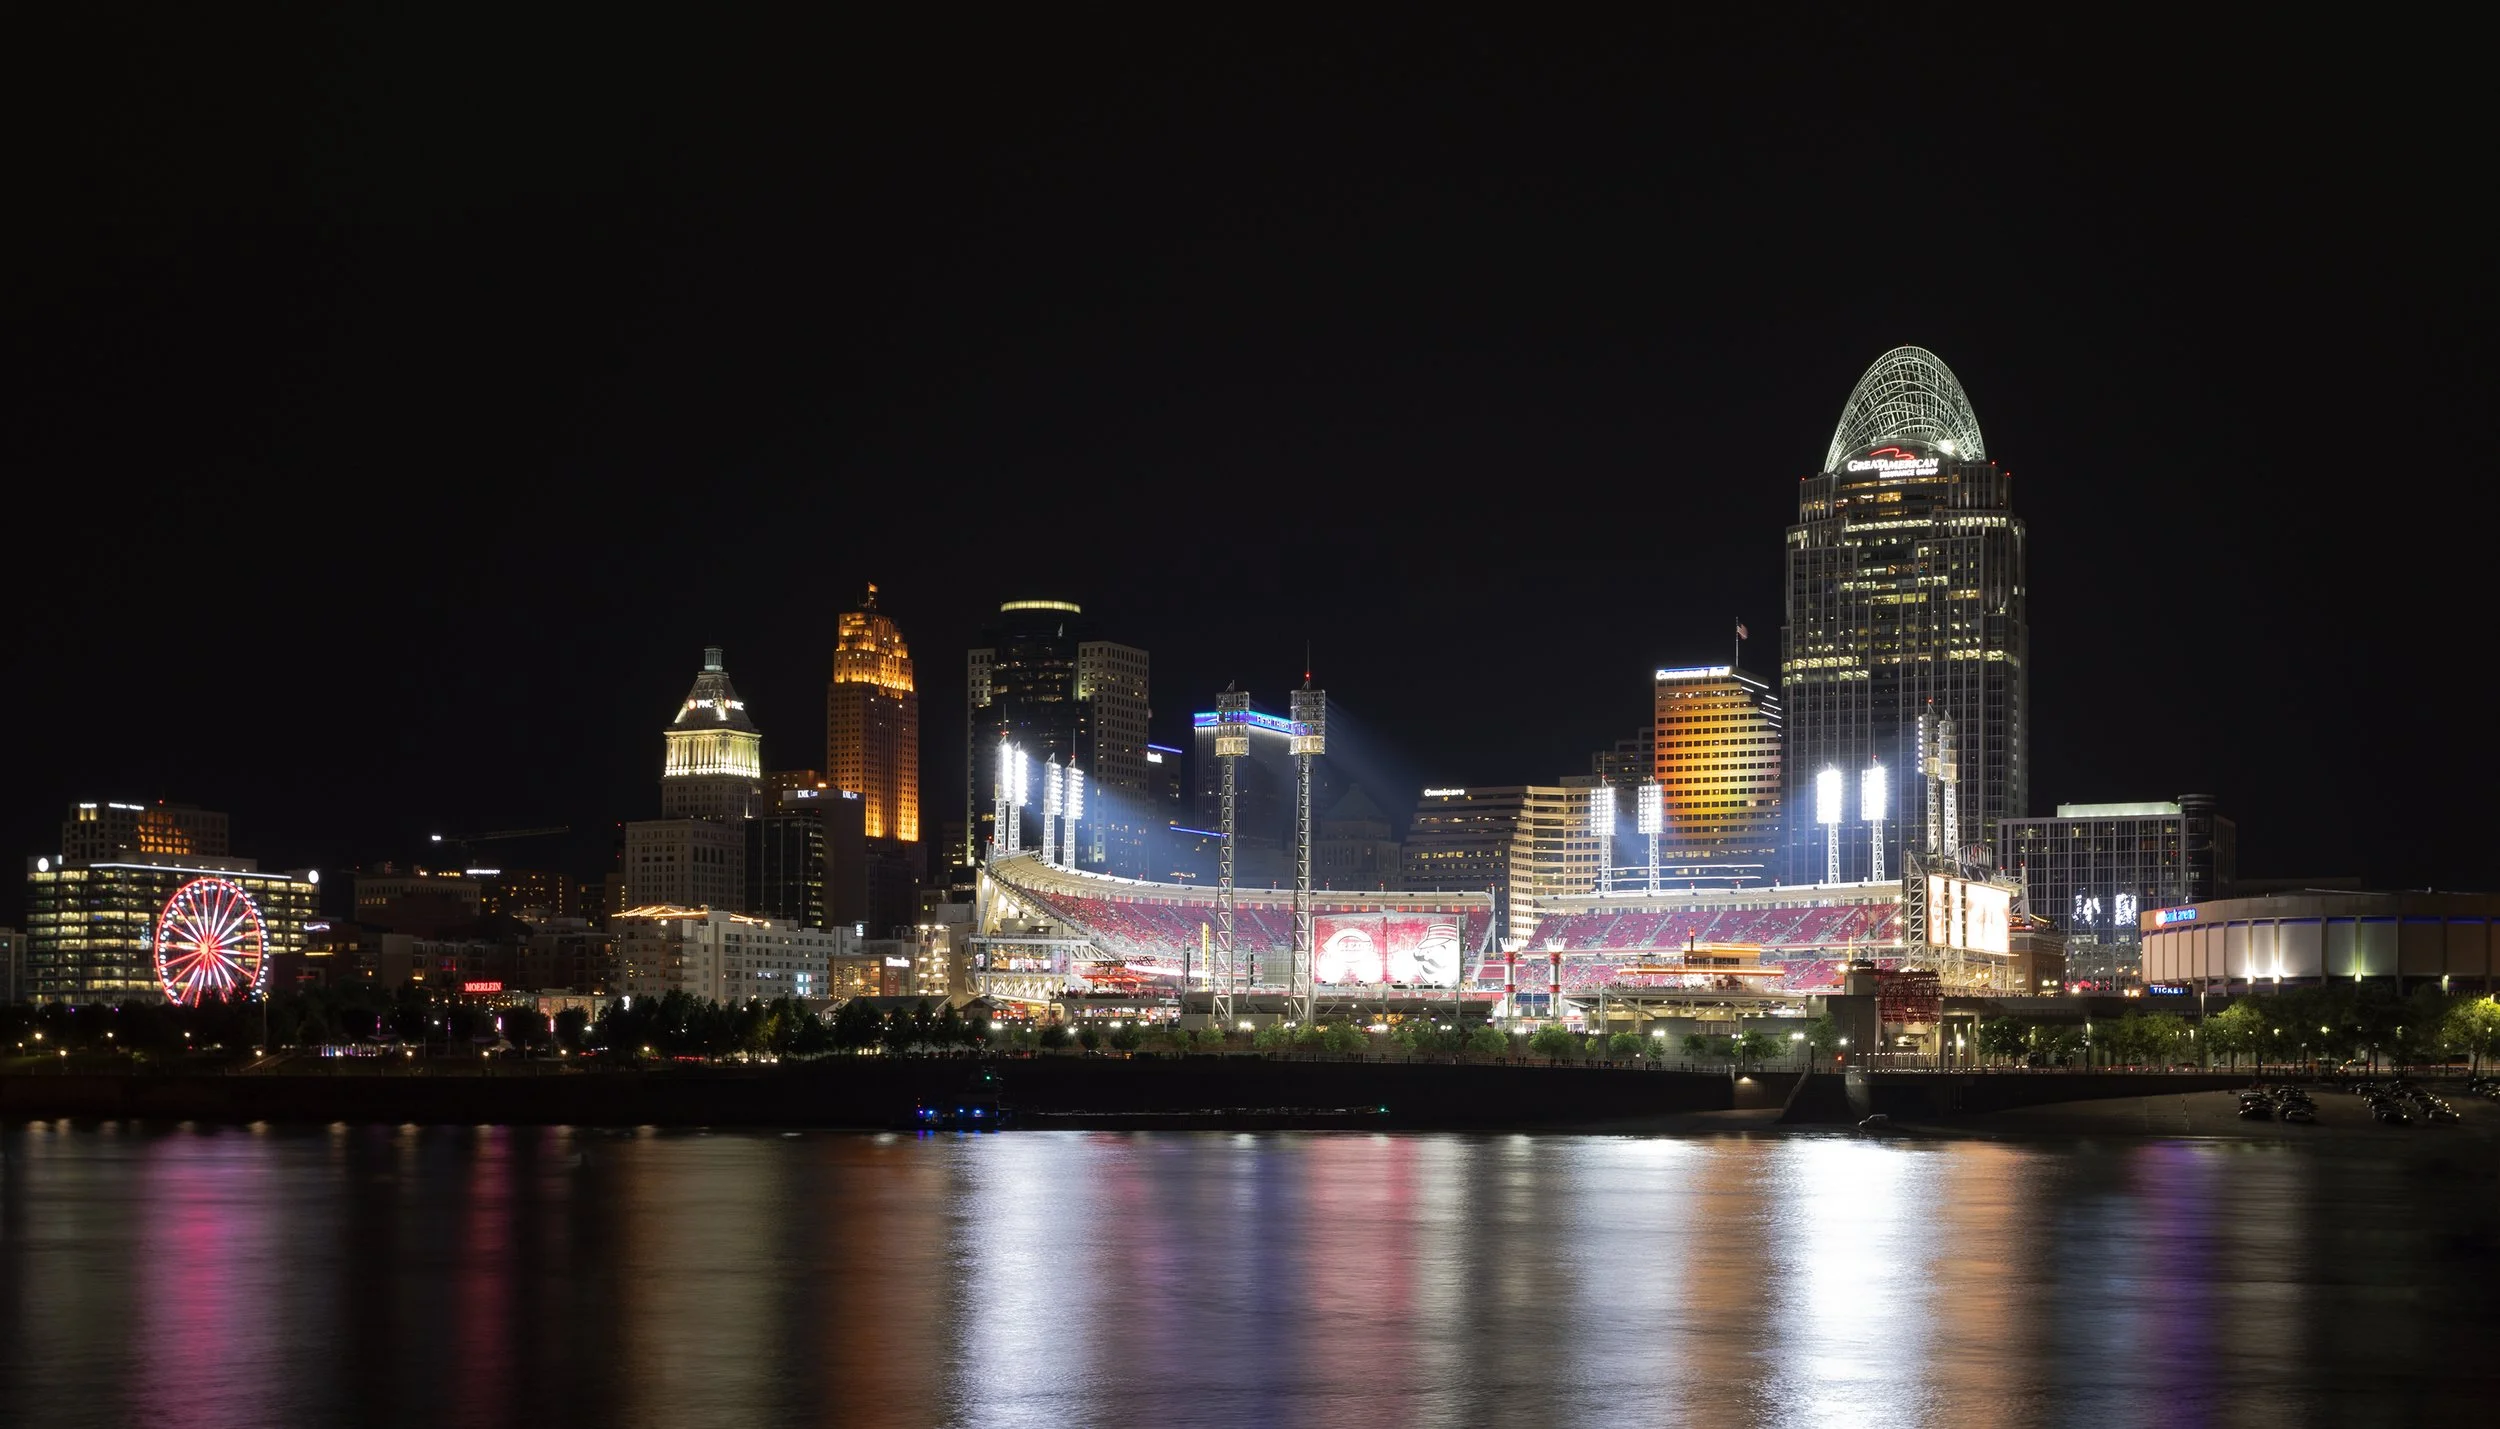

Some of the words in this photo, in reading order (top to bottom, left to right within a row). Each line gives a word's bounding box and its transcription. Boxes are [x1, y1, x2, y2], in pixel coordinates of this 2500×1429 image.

[697, 699, 714, 709] PNC
[1424, 788, 1465, 797] Omnicare
[465, 982, 502, 992] MOERLEIN
